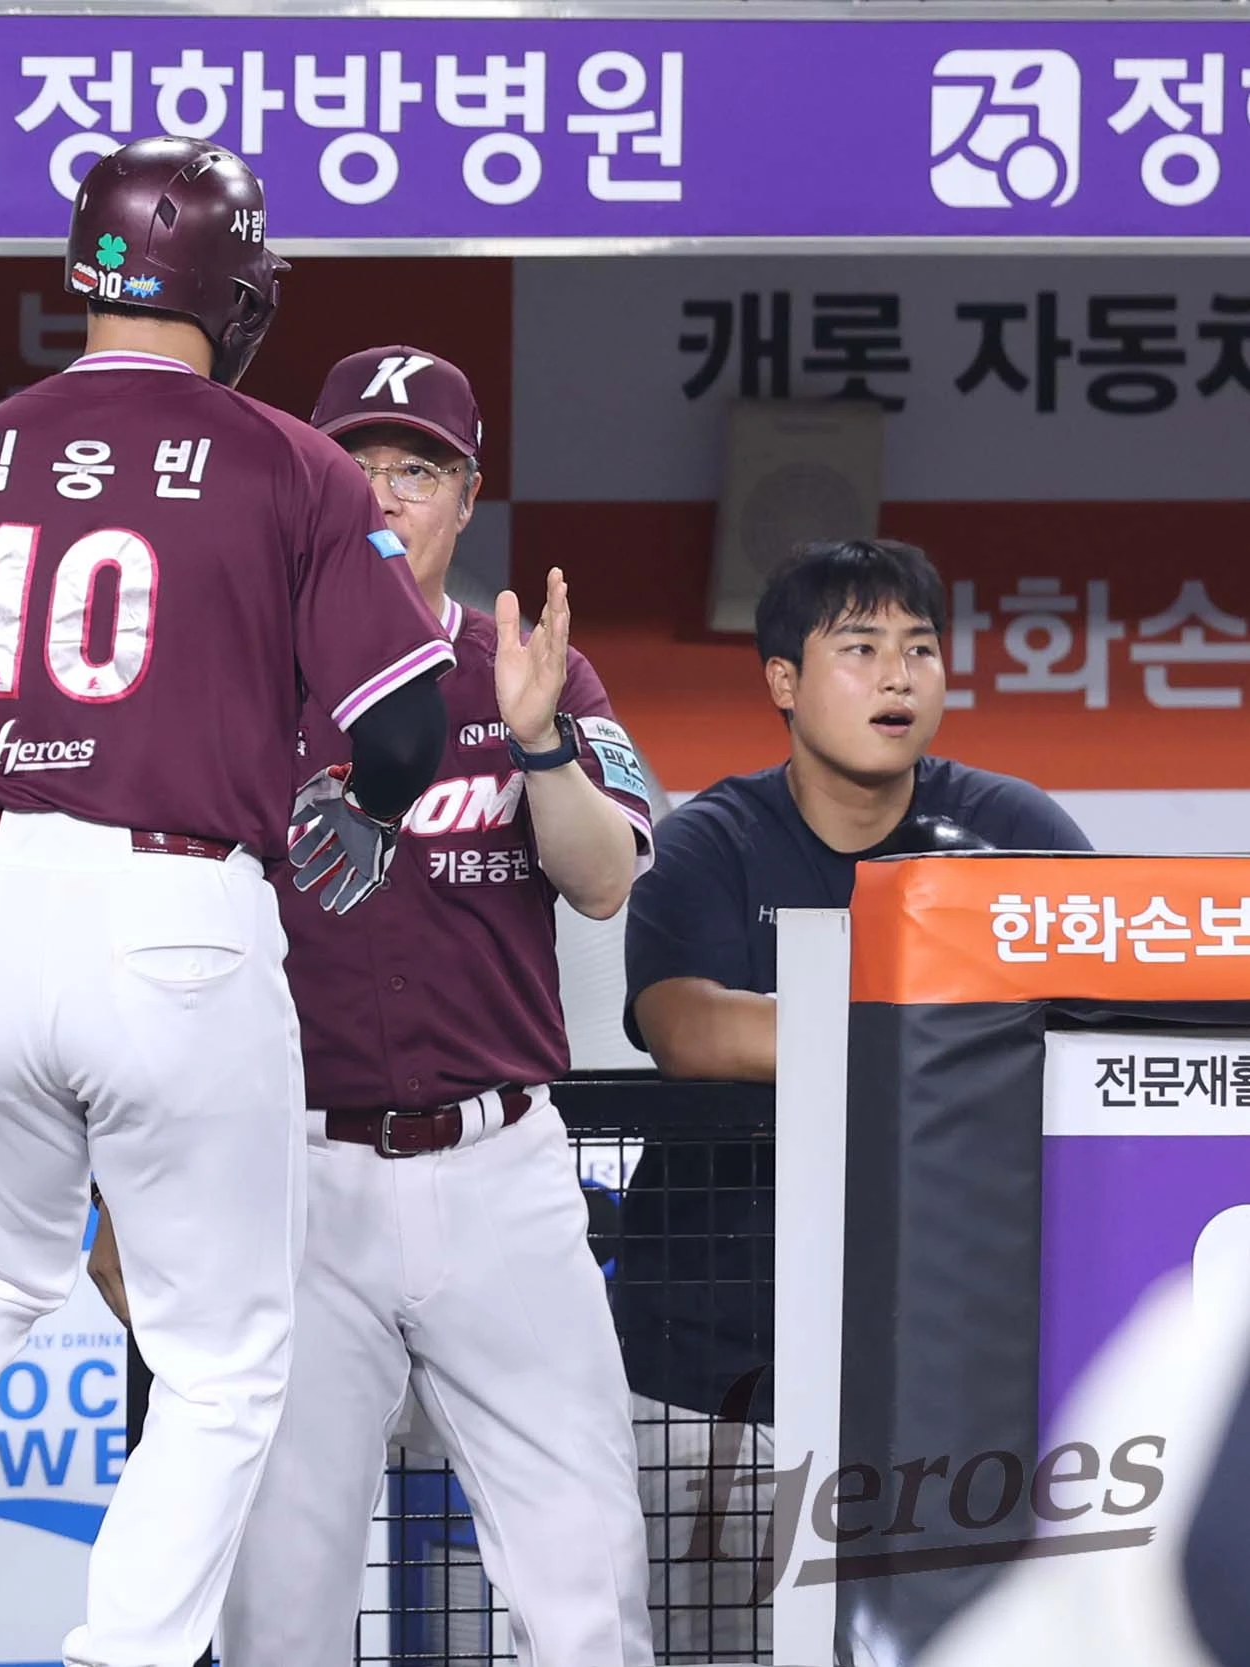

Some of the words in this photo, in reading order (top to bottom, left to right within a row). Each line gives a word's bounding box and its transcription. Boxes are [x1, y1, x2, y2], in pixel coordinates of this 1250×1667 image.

[1107, 52, 1250, 206] 정
[98, 270, 123, 299] 10
[678, 291, 911, 412] 캐롯
[360, 355, 434, 404] K
[430, 849, 530, 884] 키움증권
